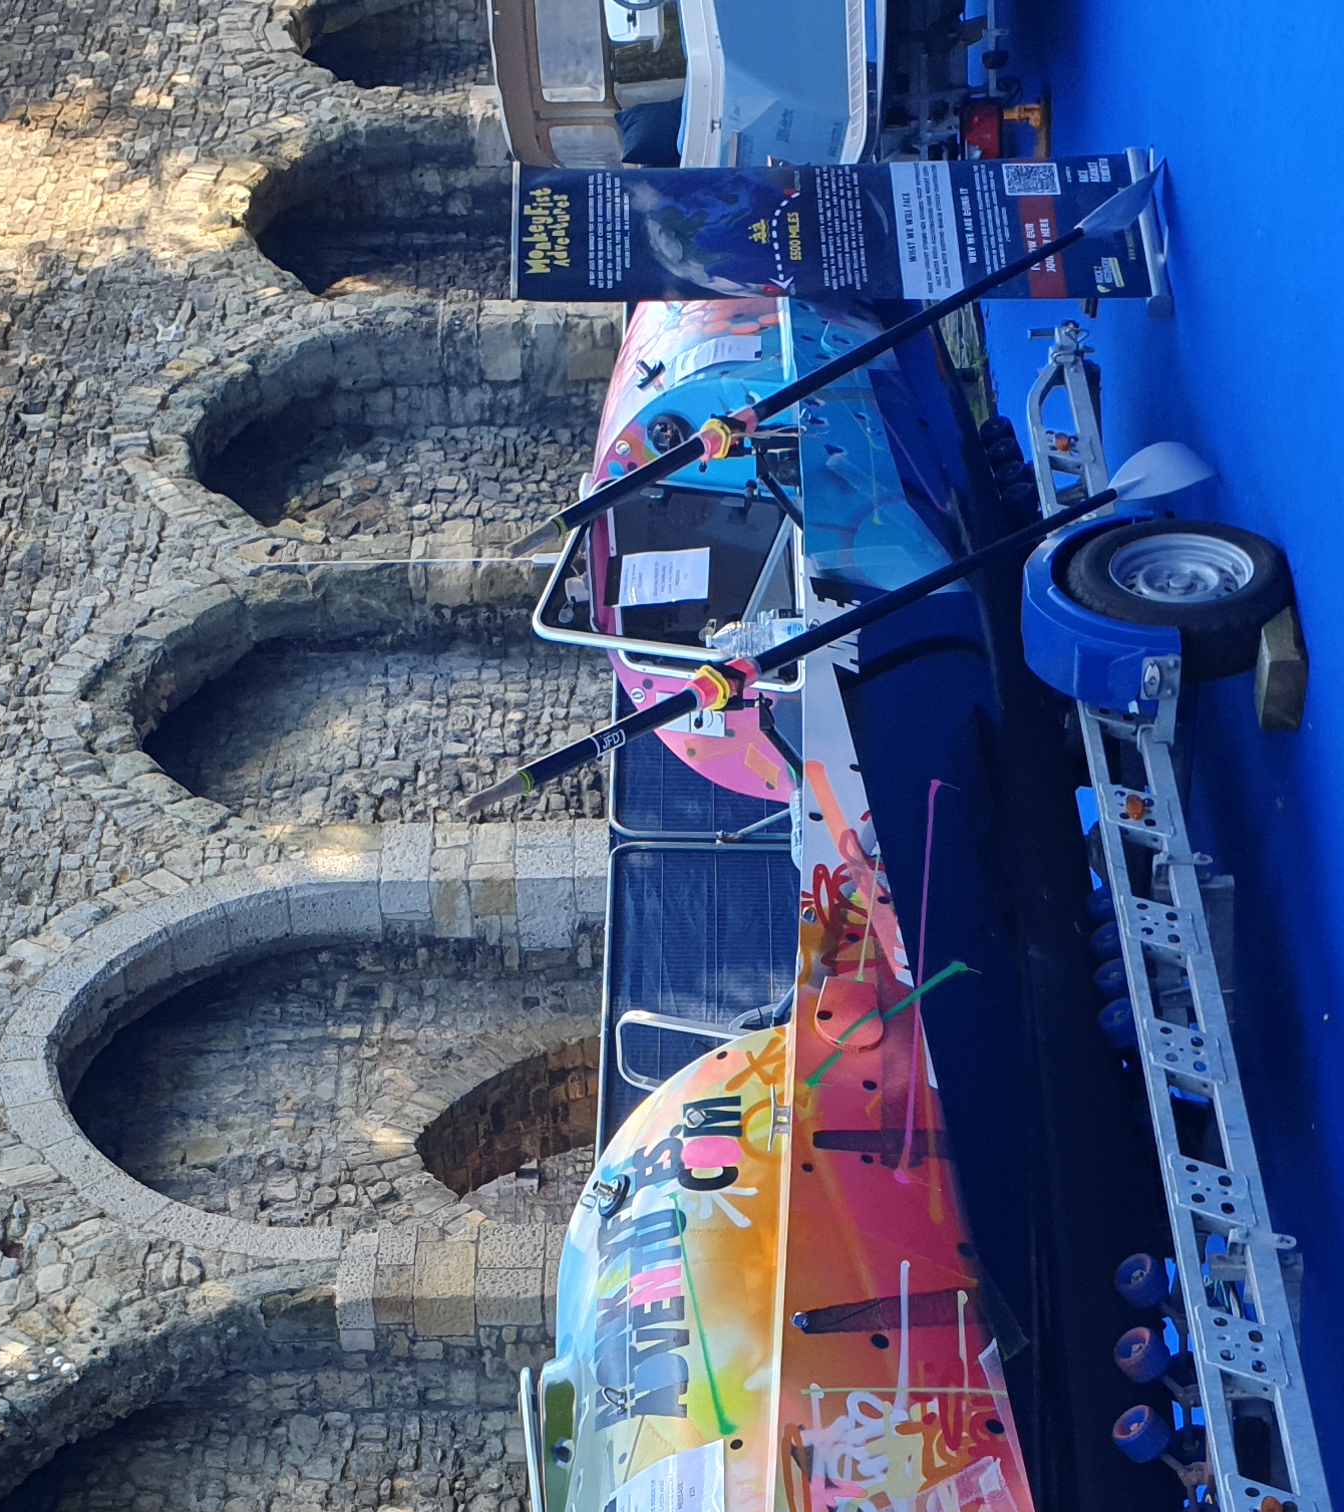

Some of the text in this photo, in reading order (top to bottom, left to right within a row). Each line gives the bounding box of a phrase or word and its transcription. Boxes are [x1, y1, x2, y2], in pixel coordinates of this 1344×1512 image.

[546, 193, 571, 267] Adventures
[787, 211, 802, 261] 5500 MILES
[901, 192, 917, 263] WHAT WE WILL FACE
[959, 187, 977, 264] WHY WE ARE DOING IT
[1024, 223, 1036, 239] OUR
[1039, 218, 1051, 238] HERE
[677, 1095, 744, 1192] COM
